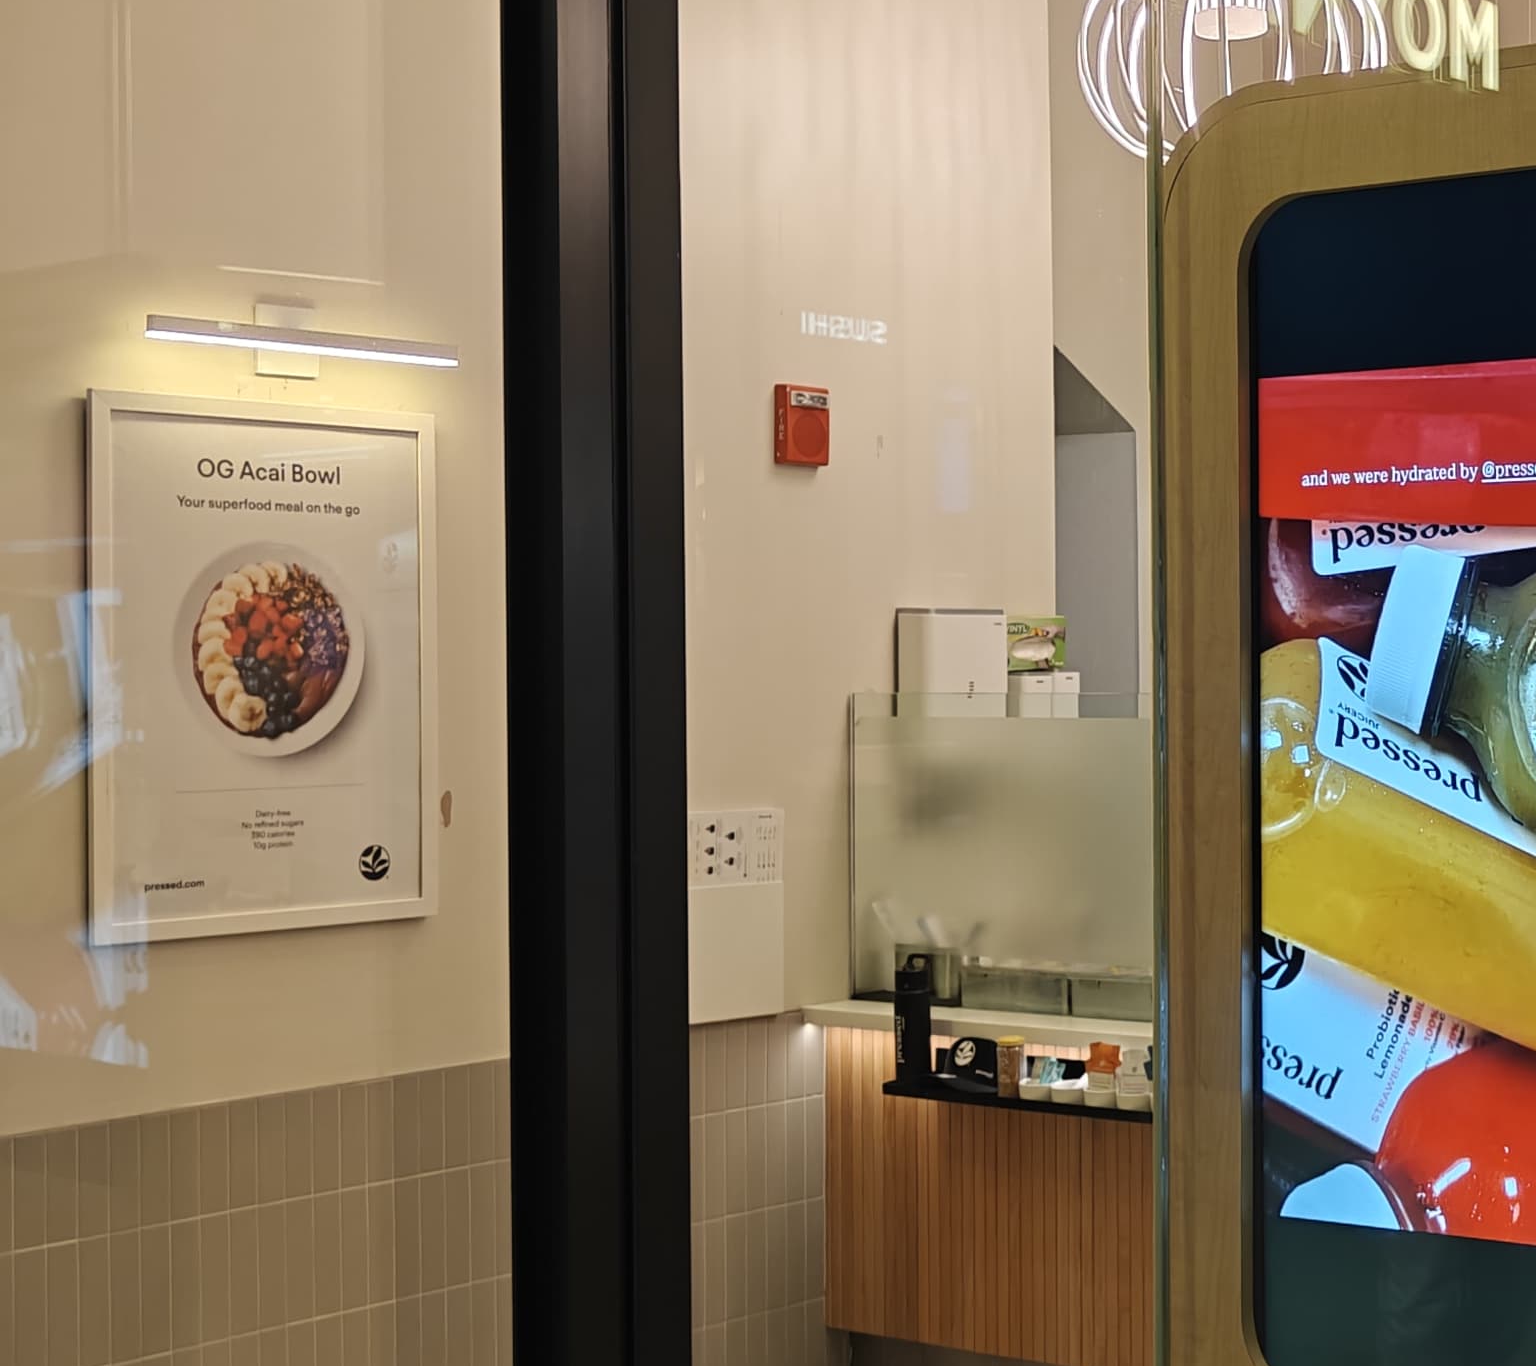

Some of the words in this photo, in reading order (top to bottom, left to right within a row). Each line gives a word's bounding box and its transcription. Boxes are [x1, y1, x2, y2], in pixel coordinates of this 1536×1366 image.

[197, 458, 234, 478] OG
[240, 460, 285, 482] Acai
[292, 463, 340, 485] Bowl
[1302, 469, 1328, 487] and
[1331, 471, 1351, 485] we
[1354, 469, 1388, 485] were
[1391, 463, 1457, 489] hydrated
[1459, 462, 1478, 484] by
[177, 495, 205, 508] Your
[208, 498, 272, 512] superfood
[275, 501, 303, 513] meal
[306, 504, 321, 513] on
[324, 502, 342, 514] the
[345, 506, 360, 517] go
[1335, 712, 1483, 803] pressed
